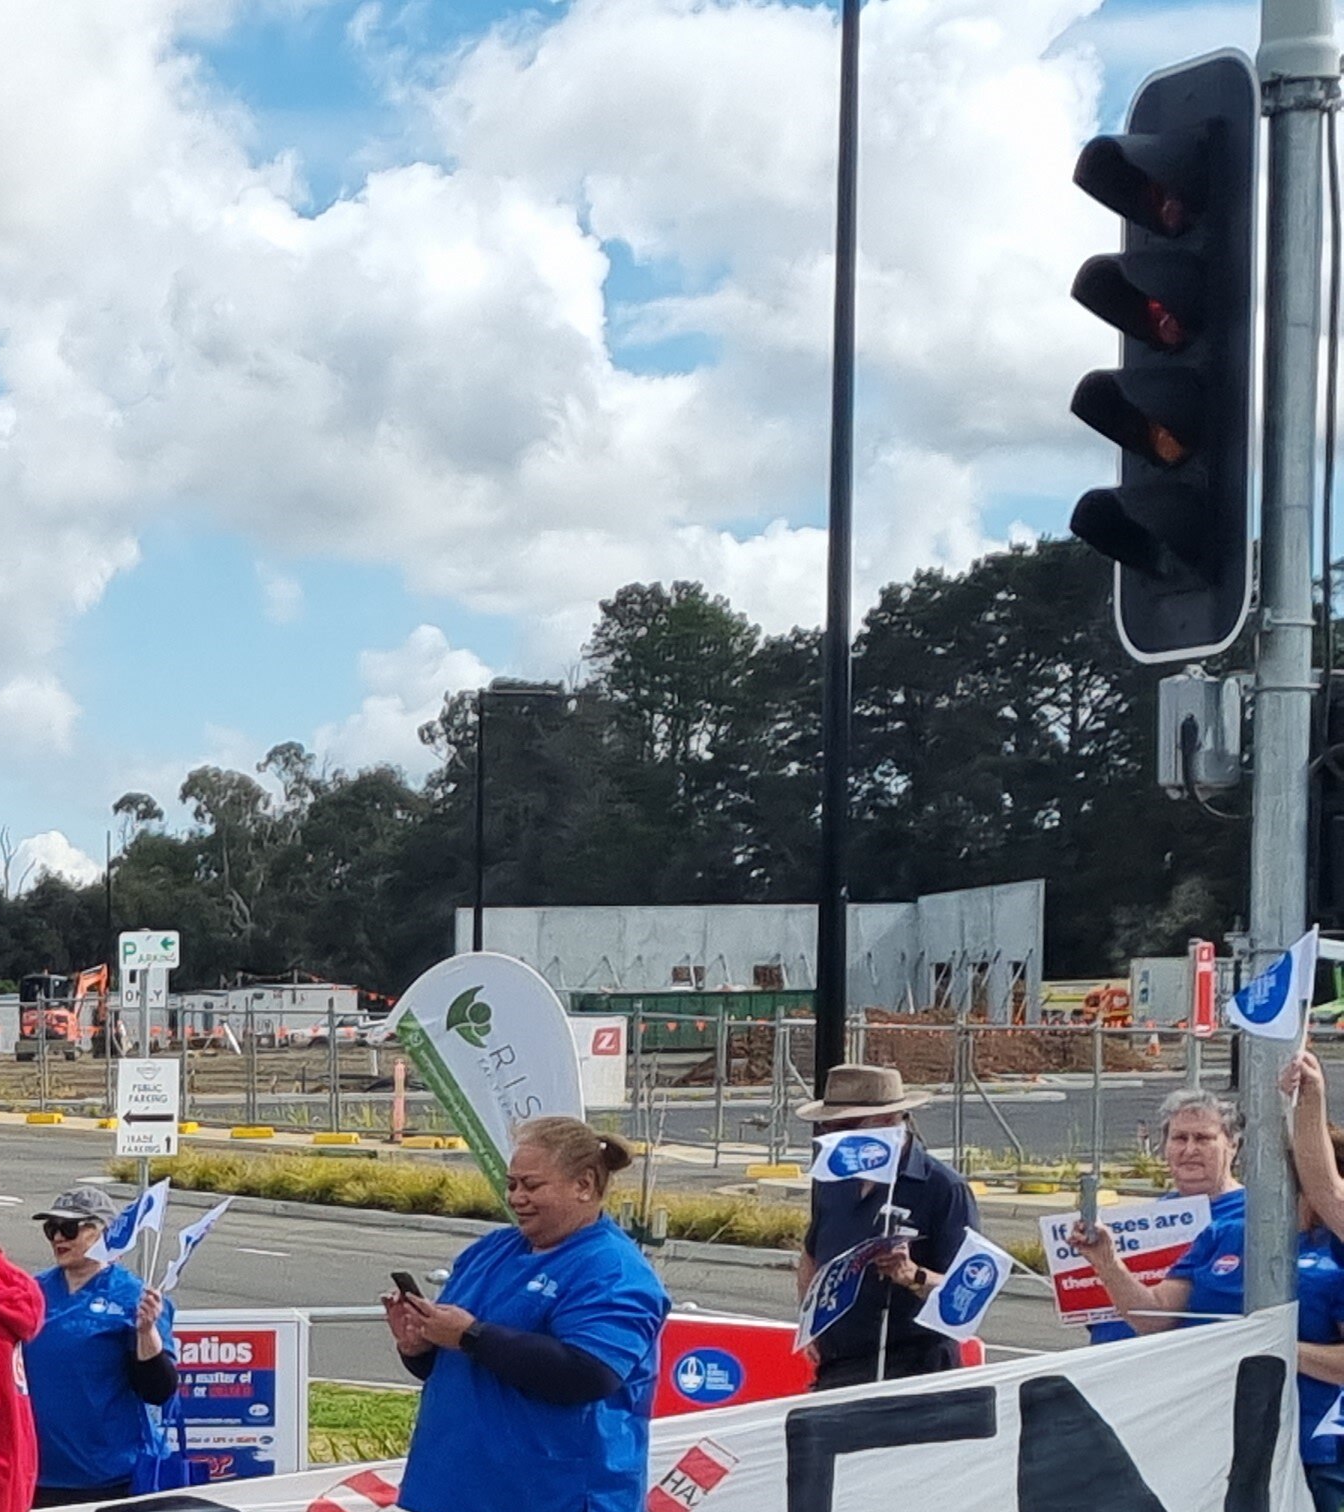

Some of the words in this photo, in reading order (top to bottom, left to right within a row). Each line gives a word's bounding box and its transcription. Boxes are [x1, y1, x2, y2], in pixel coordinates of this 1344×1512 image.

[124, 990, 163, 1003] ONY
[1051, 1223, 1069, 1242] If
[1111, 1217, 1150, 1234] ses
[1155, 1211, 1195, 1229] are
[1056, 1235, 1140, 1260] oude
